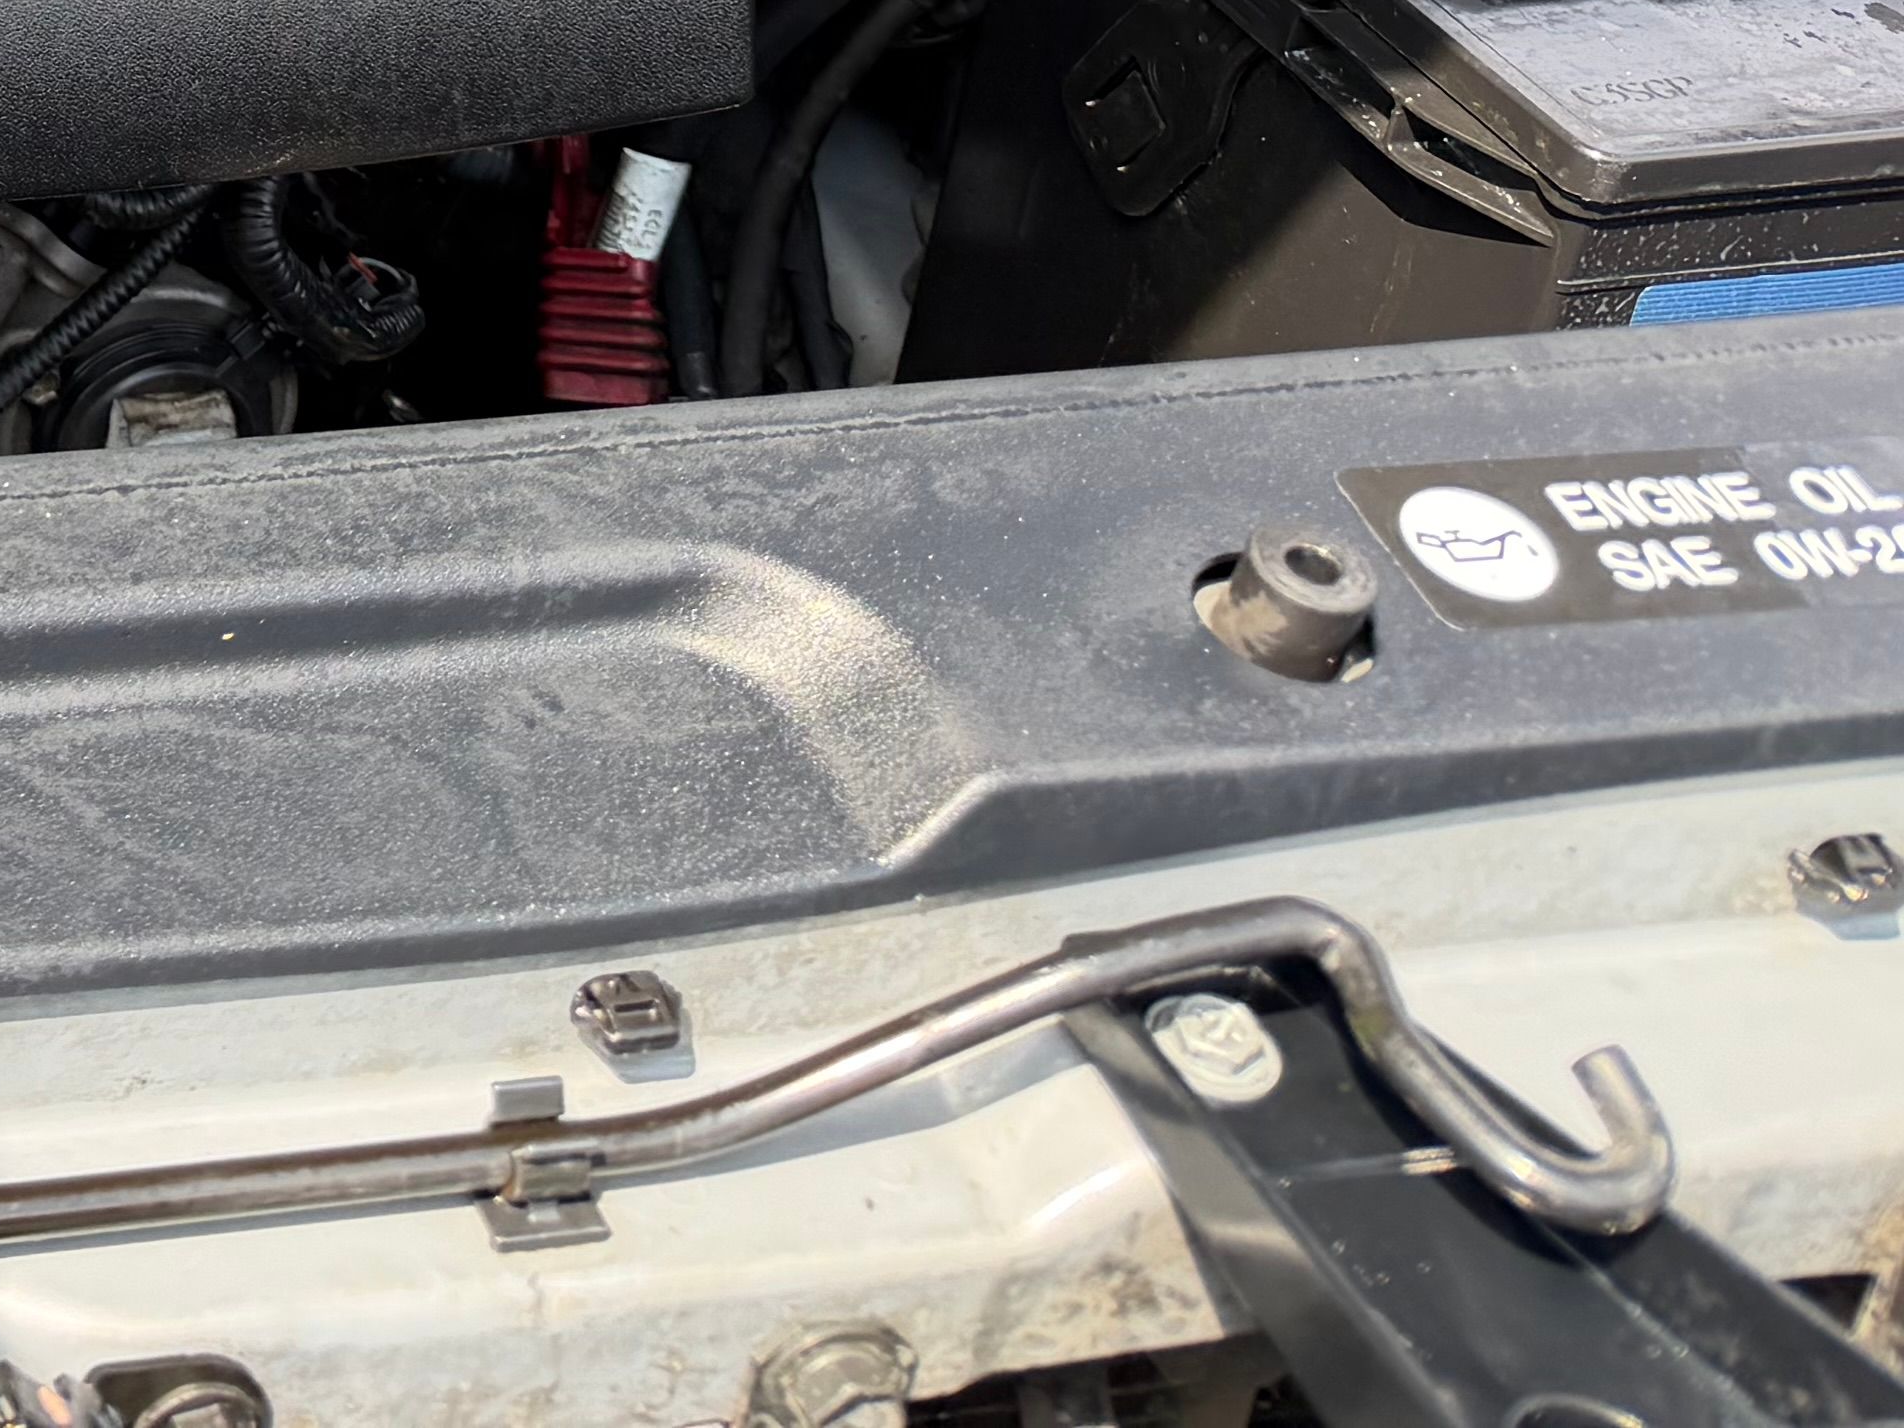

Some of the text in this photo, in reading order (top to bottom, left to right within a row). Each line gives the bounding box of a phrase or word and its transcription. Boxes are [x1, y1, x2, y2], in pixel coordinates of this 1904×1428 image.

[1544, 465, 1903, 531] ENGINE OIL
[1597, 535, 1740, 591] SAE
